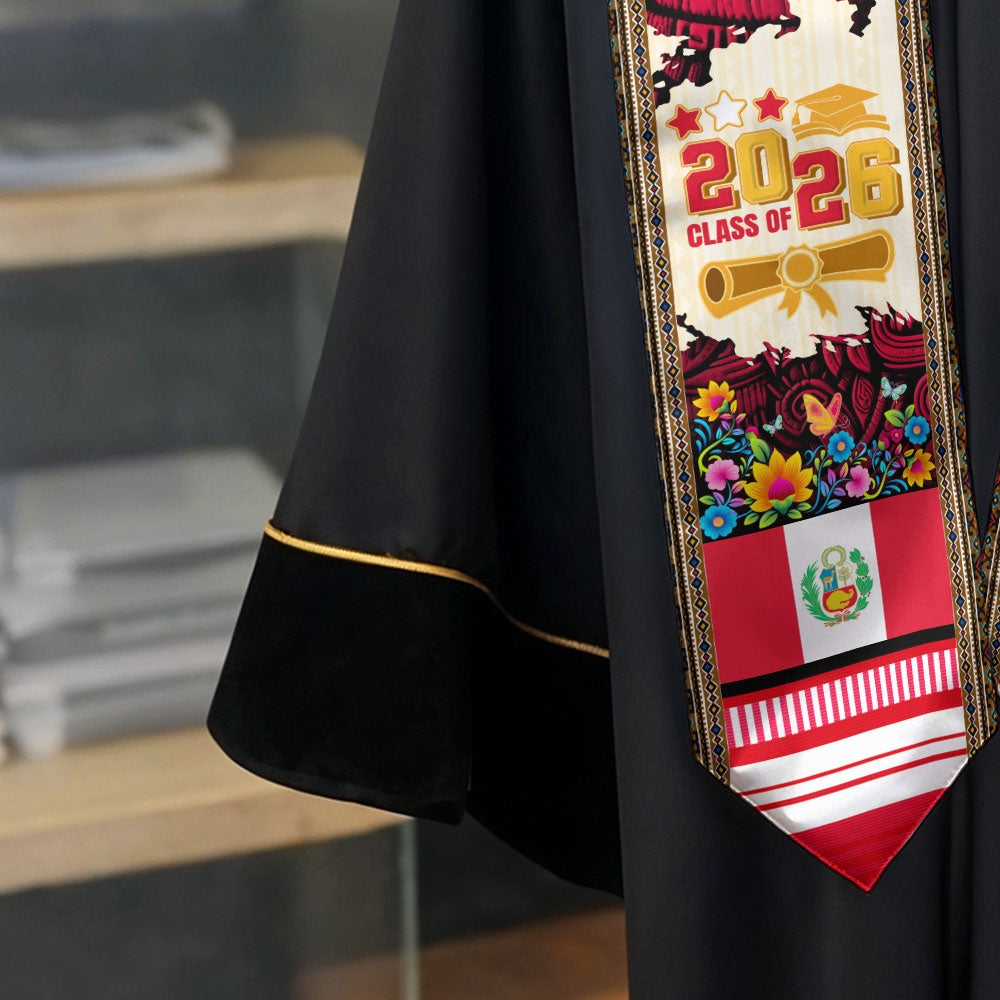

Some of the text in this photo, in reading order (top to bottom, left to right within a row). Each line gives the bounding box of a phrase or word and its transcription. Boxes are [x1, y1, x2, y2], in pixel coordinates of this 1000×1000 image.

[679, 128, 904, 231] 2026
[687, 207, 792, 248] CLASS OF
